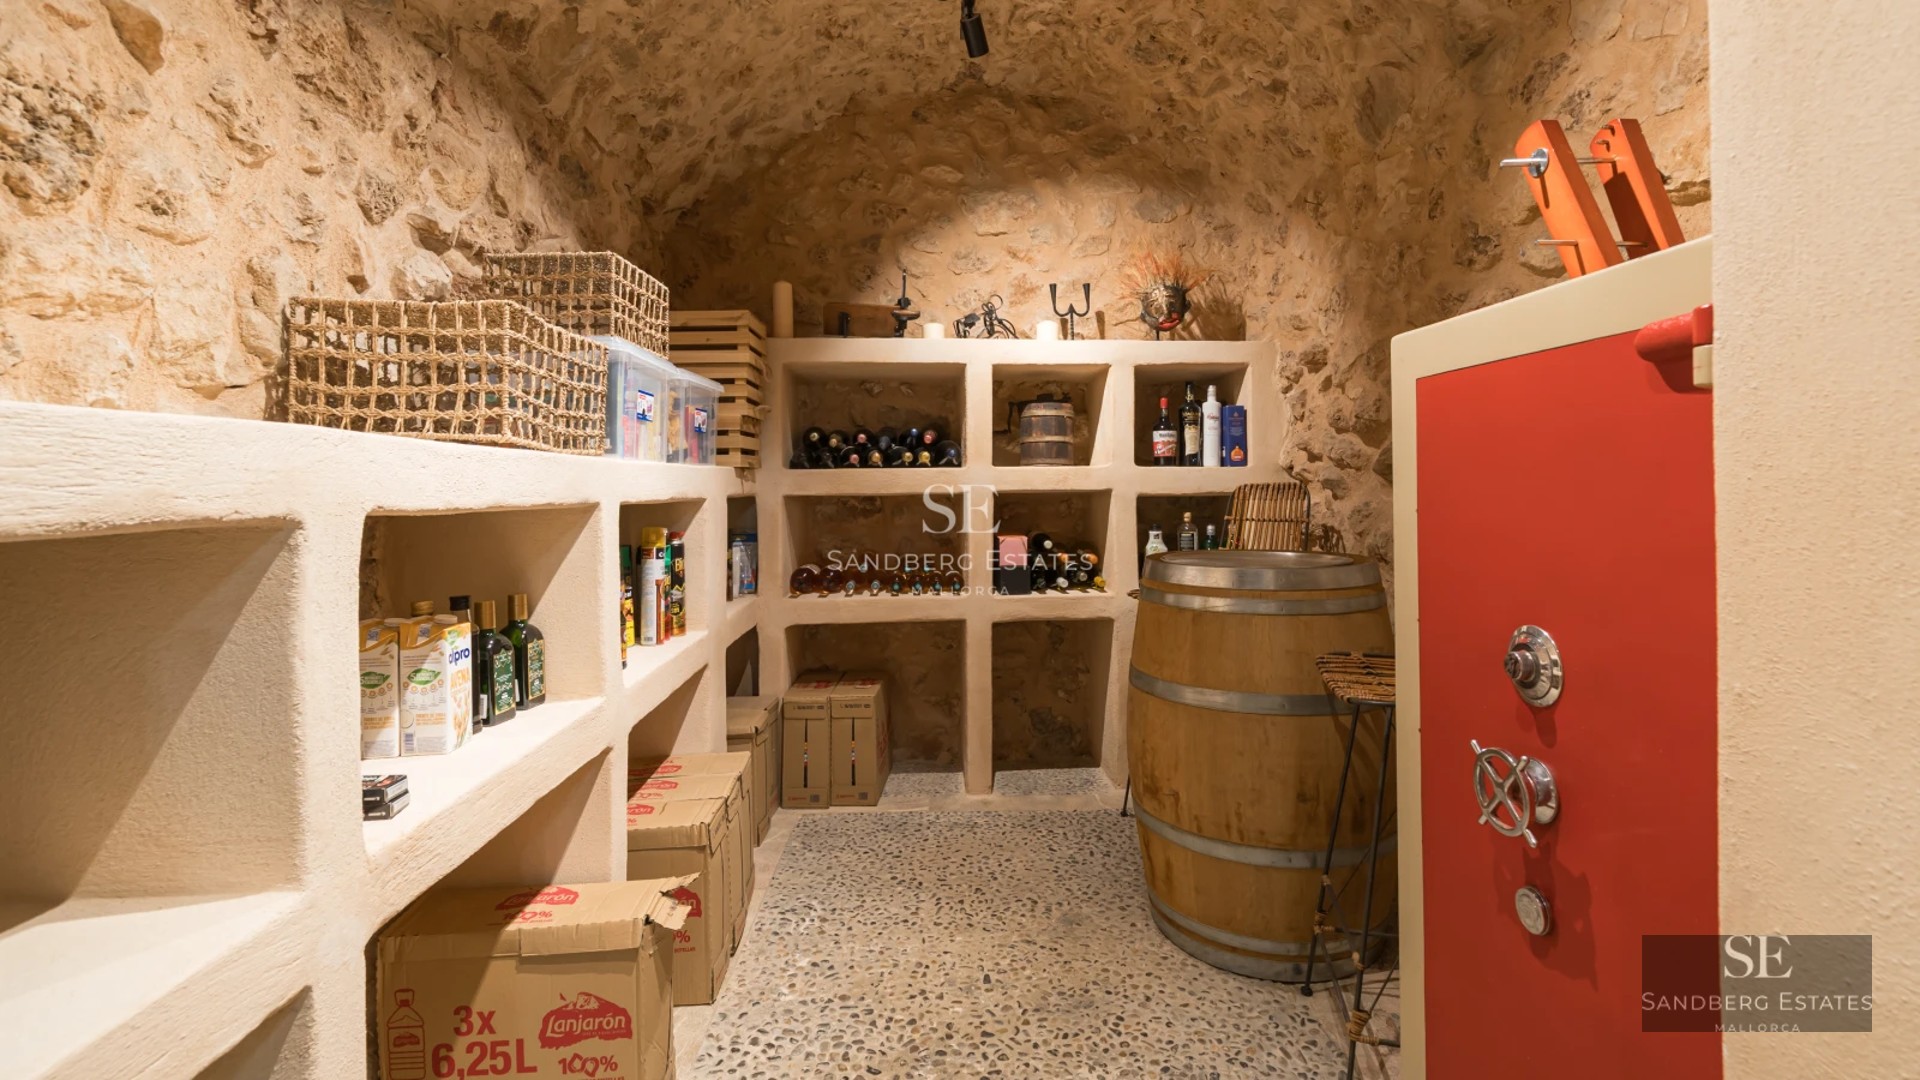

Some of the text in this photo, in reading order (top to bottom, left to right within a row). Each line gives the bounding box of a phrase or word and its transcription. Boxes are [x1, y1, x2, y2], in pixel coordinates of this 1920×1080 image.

[448, 647, 470, 666] alpro
[453, 1005, 496, 1037] 3x
[545, 1012, 627, 1038] Lanjarón
[558, 1052, 619, 1078] 100%
